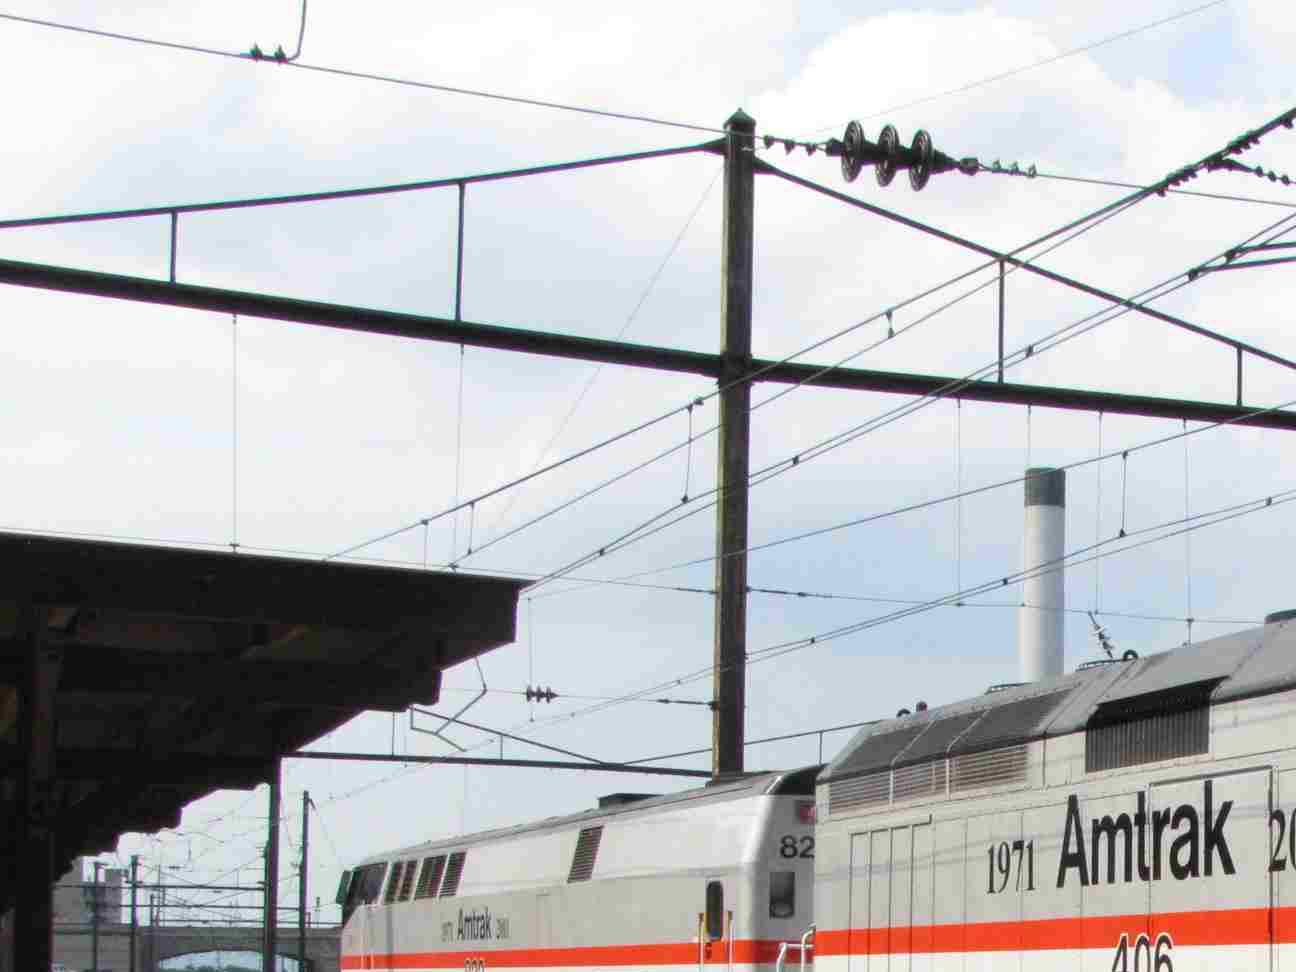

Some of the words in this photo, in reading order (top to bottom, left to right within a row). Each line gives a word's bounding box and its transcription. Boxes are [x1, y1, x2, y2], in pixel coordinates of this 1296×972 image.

[987, 837, 1035, 894] 1971
[1056, 780, 1236, 888] Amtrak
[457, 905, 492, 941] Amtrak
